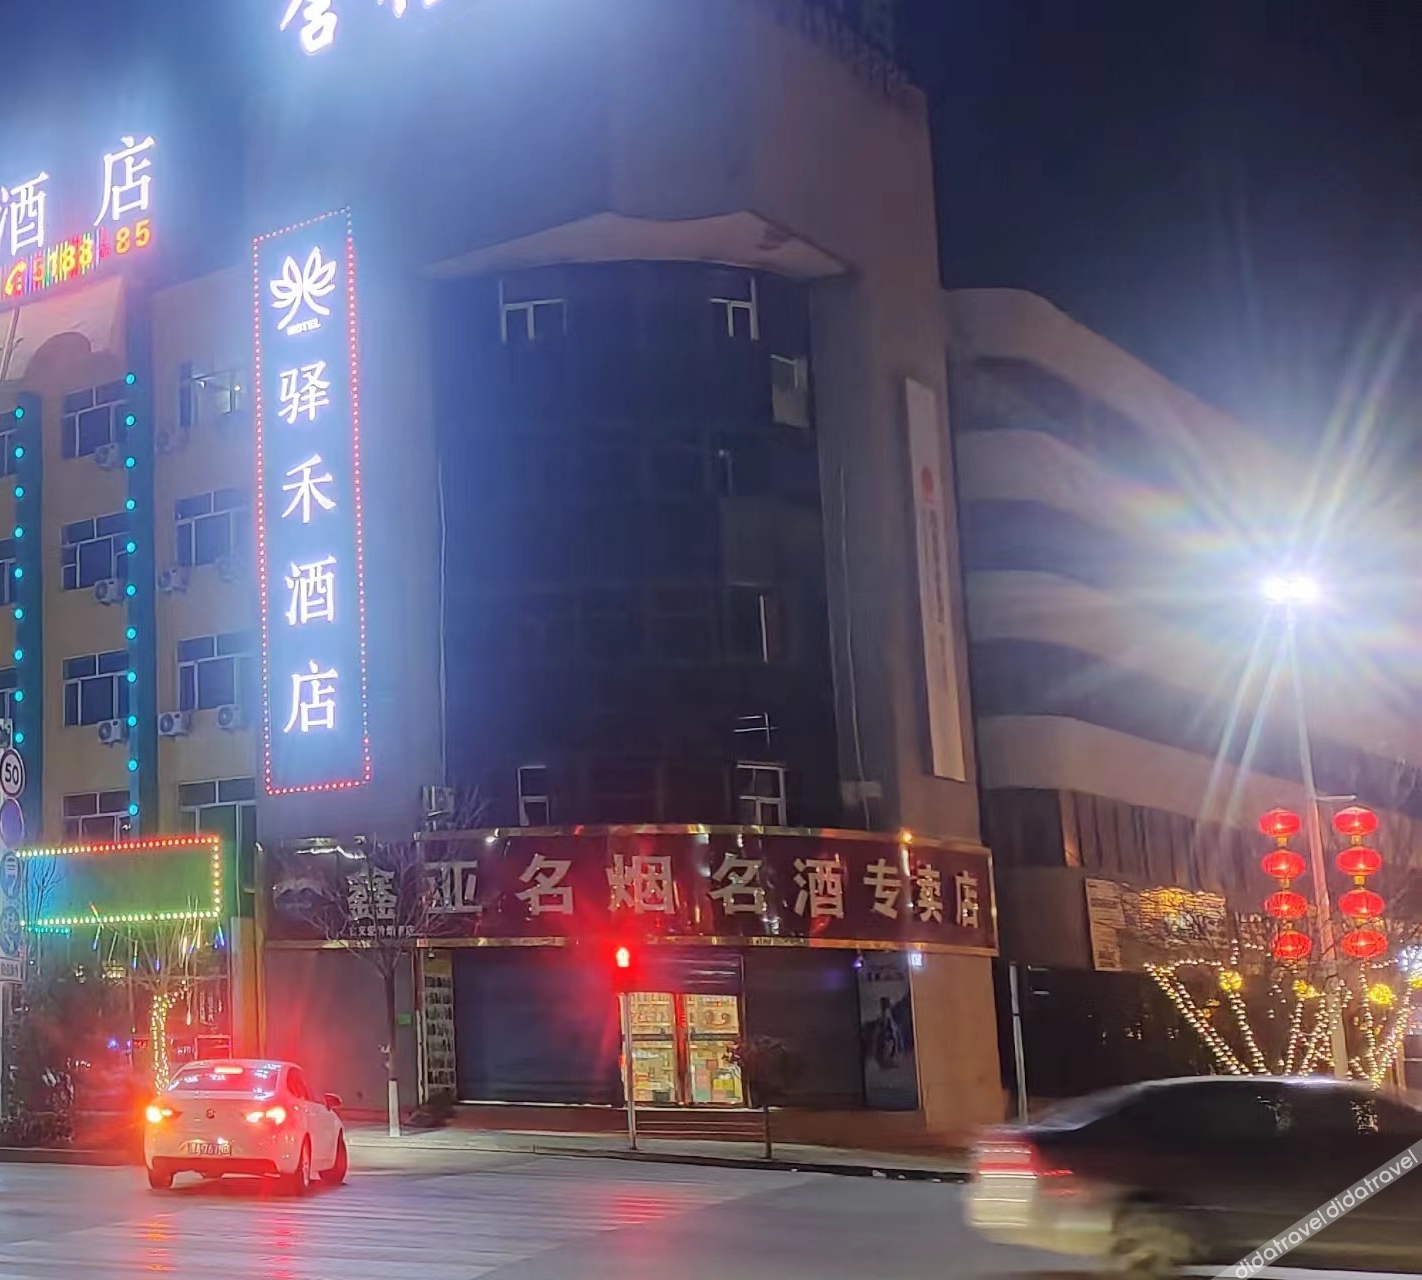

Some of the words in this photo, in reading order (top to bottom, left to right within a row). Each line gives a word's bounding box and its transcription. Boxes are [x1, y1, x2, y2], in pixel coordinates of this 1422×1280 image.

[278, 360, 339, 734] 驿禾酒店
[3, 763, 20, 786] 50
[345, 852, 979, 931] 鑫亚名烟名酒专卖店
